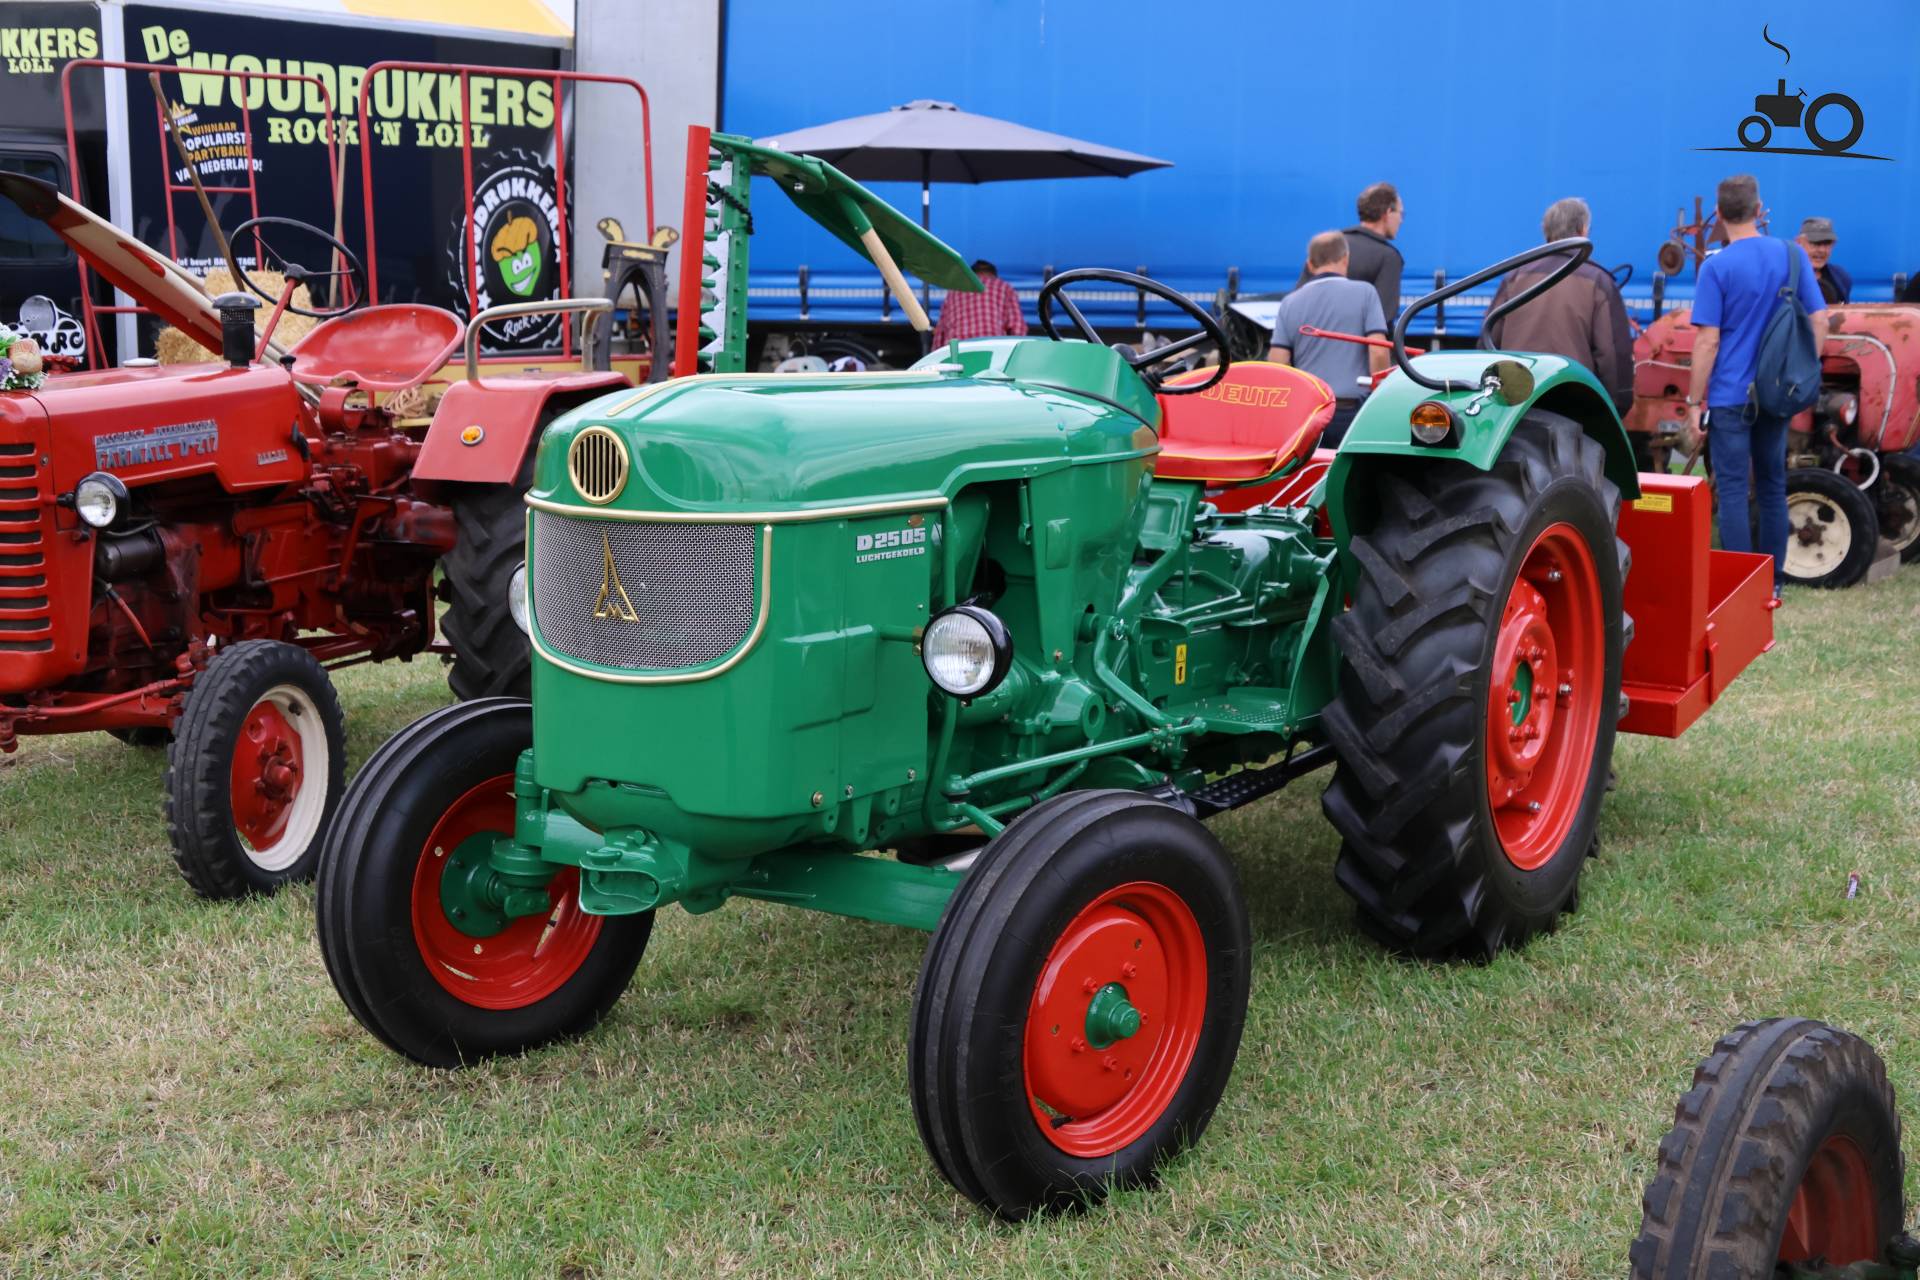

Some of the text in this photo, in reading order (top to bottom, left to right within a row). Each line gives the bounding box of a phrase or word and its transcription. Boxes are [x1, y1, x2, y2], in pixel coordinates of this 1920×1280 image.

[0, 27, 98, 58] KKERS
[141, 25, 190, 62] De
[8, 57, 54, 74] LOLL
[176, 51, 555, 129] WOUDRUKKERS
[182, 132, 252, 151] OPULAIRST
[191, 121, 237, 136] WINNAAR
[267, 117, 360, 145] ROCK
[1200, 382, 1291, 407] DEUTZ
[95, 441, 173, 470] FARMALL
[856, 546, 926, 563] LUCHTGEKOELD
